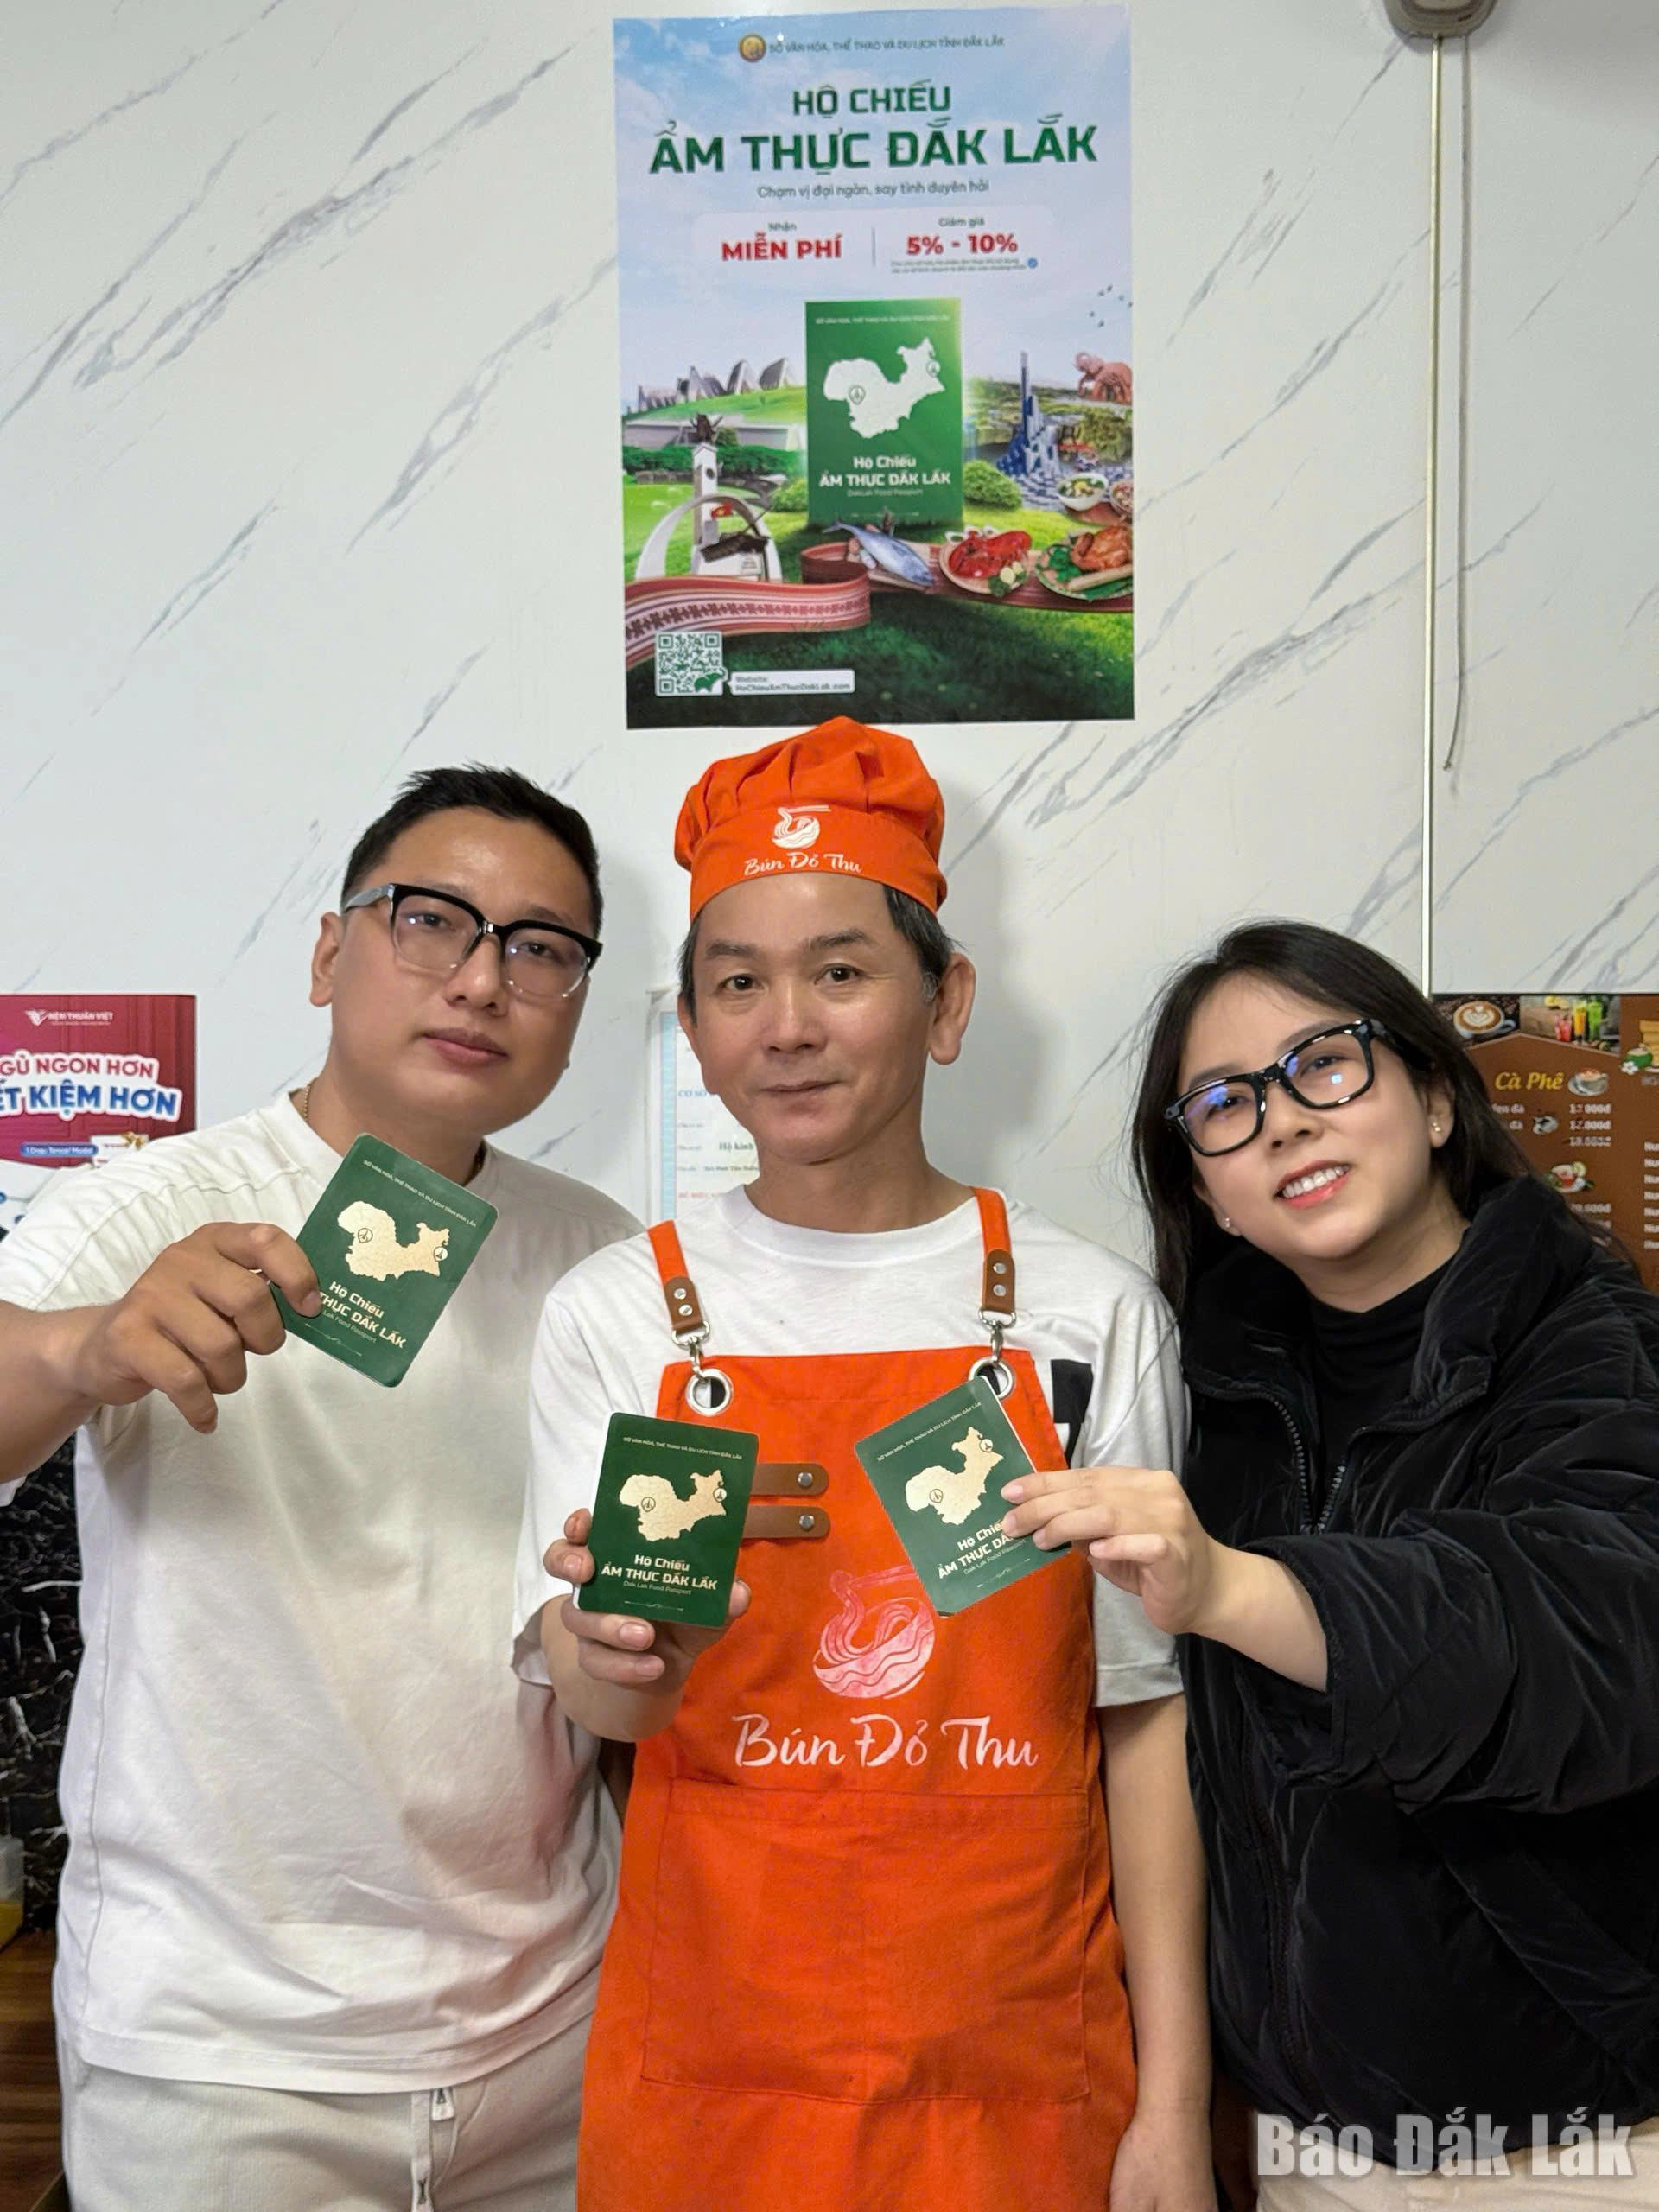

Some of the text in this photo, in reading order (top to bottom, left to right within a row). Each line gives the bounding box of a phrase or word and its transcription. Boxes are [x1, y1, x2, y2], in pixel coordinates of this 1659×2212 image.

[793, 79, 950, 118] HỘ CHIẾU
[650, 113, 1097, 175] ẨM THỰC ĐẮK LẮK
[721, 231, 842, 261] MIỄN PHÍ
[906, 235, 944, 255] 5%
[968, 233, 1018, 253] 10%
[823, 854, 862, 874] Thu
[0, 1054, 154, 1078] GỦ NGON HƠN
[1495, 1071, 1565, 1090] Cà Phê
[29, 1079, 101, 1115] KIỆM
[110, 1086, 177, 1116] HƠN
[329, 1281, 385, 1319] Hộ Chiếu
[351, 1310, 380, 1333] ĐẮK
[379, 1327, 407, 1349] LẮK
[957, 1519, 1004, 1552] Hộ Chiế
[601, 1560, 718, 1591] ẨM THỰC ĐẮK LẮK
[634, 1554, 690, 1573] Hộ Chiếu
[938, 1562, 958, 1580] ẨM
[958, 1542, 992, 1572] THỰC
[732, 1713, 1039, 1770] Bún Đỏ Thu
